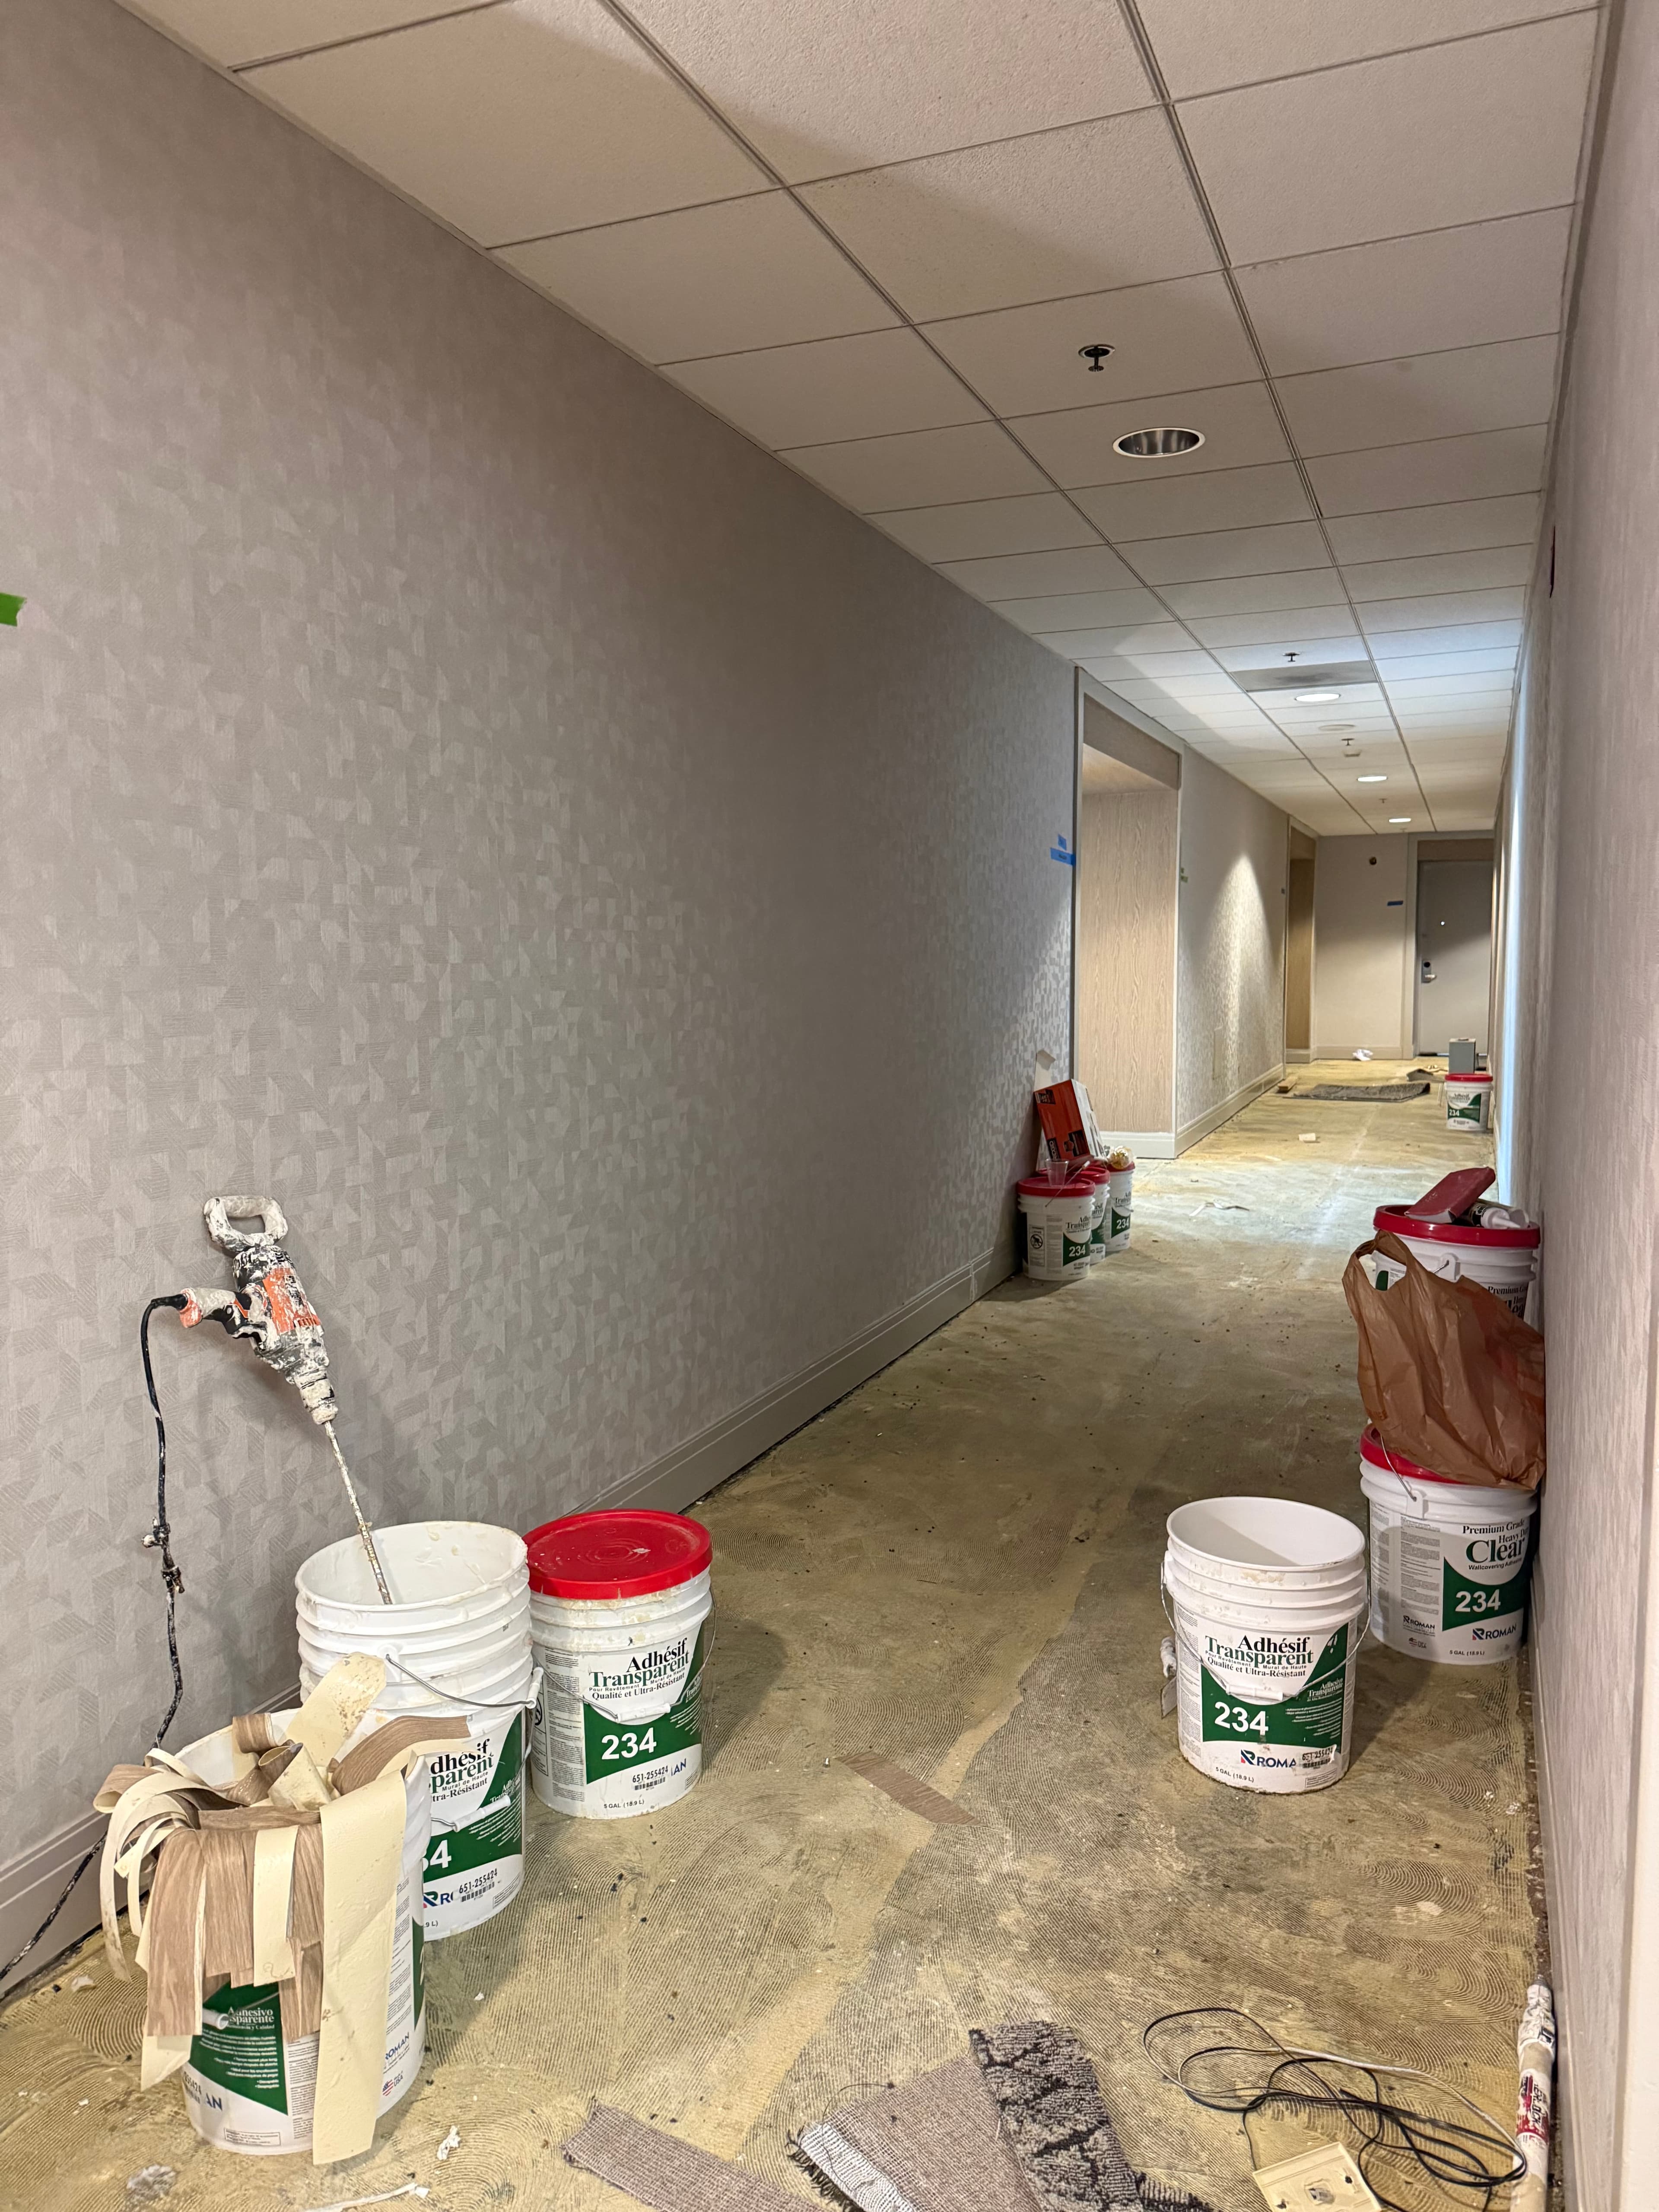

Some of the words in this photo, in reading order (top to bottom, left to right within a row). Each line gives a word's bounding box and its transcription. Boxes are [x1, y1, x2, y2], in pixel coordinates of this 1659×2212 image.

[1116, 1218, 1129, 1229] 234
[1069, 1245, 1086, 1257] 234
[1463, 1525, 1504, 1534] Premium
[1499, 1533, 1519, 1544] Heavy
[1466, 1538, 1525, 1563] Clear
[1455, 1589, 1501, 1612] 234
[1411, 1620, 1435, 1629] ROMAN
[1485, 1623, 1517, 1640] ROMAN
[1205, 1635, 1313, 1668] Transparent
[1238, 1635, 1310, 1653] Adhésif
[626, 1637, 688, 1672] Adhésif
[589, 1649, 690, 1687] Transparent
[674, 1667, 685, 1675] Haute
[1208, 1656, 1233, 1670] Qualité
[1246, 1666, 1305, 1677] Ultra-Résistant
[592, 1690, 622, 1700] Qualité
[634, 1673, 684, 1696] Ultra-Résistant
[1214, 1702, 1268, 1735] 234
[602, 1727, 657, 1760] 234
[430, 1738, 490, 1774] dhésif
[1257, 1757, 1296, 1767] ROMA
[442, 1783, 460, 1792] Mural
[472, 1772, 488, 1781] Haute
[632, 1765, 668, 1783] 651-255424
[1220, 1768, 1231, 1777] GAL
[1233, 1773, 1247, 1781] (18.9
[432, 1778, 487, 1802] tra-Résistant
[459, 1868, 497, 1894] 651-255424
[394, 2074, 404, 2087] USA
